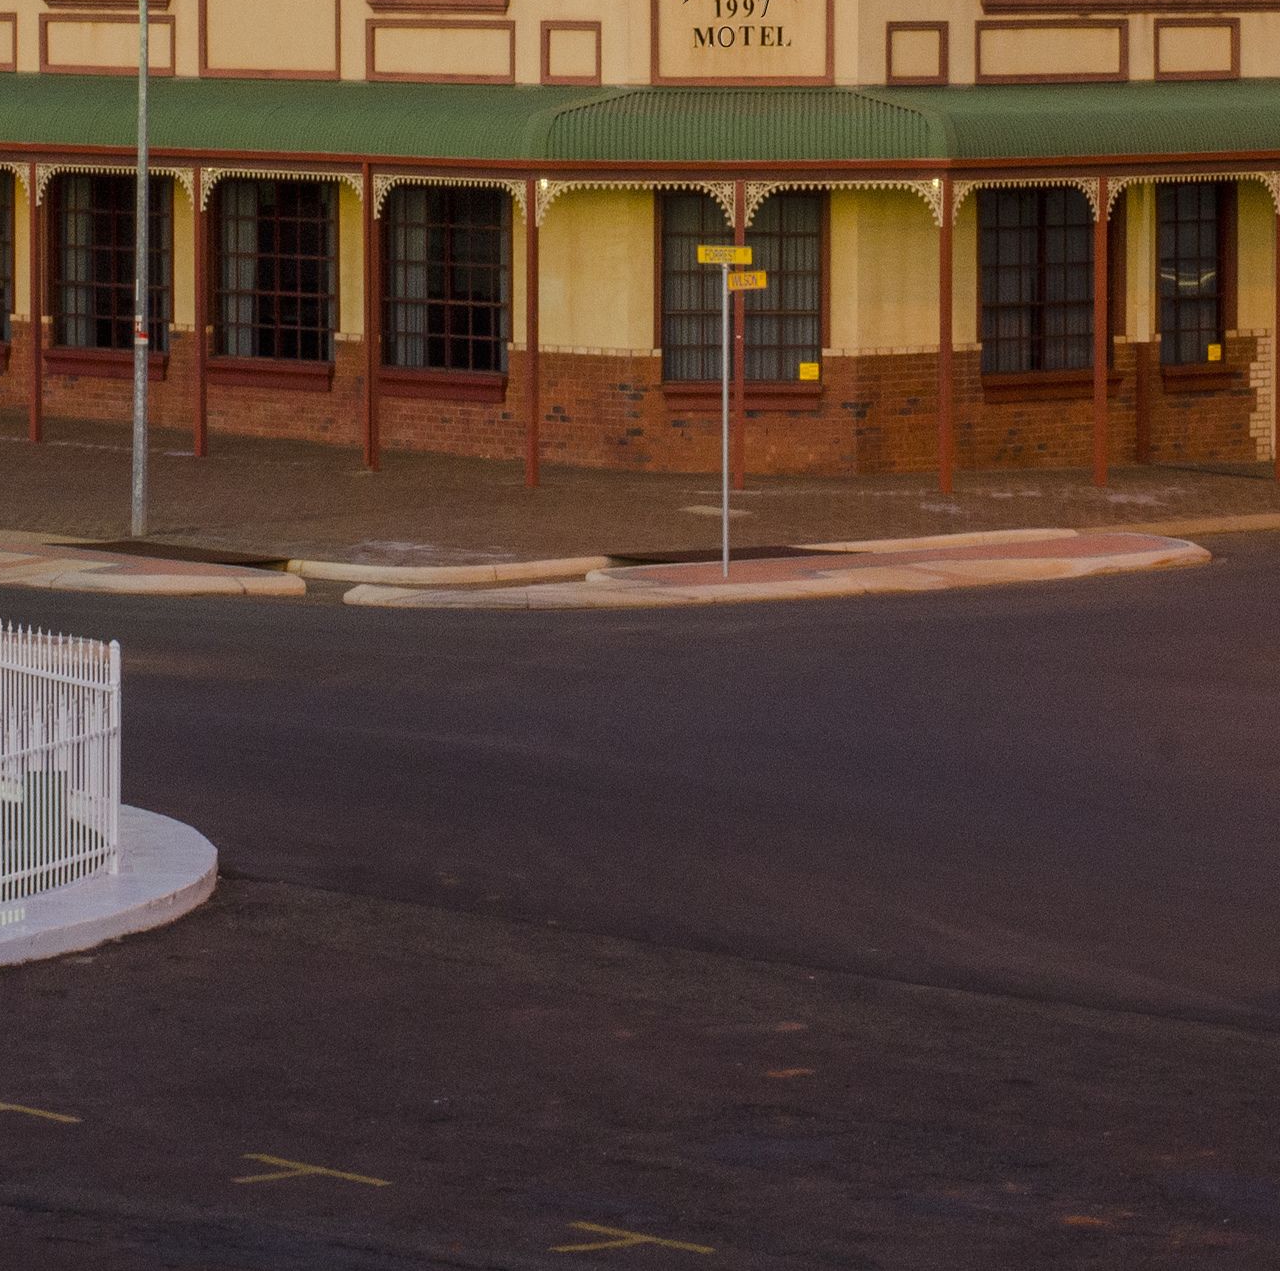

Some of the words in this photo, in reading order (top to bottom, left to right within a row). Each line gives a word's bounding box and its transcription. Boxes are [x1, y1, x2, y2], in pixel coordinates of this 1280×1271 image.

[693, 25, 792, 48] MOTEL
[705, 249, 737, 262] FORREST
[731, 273, 757, 287] WILSON
